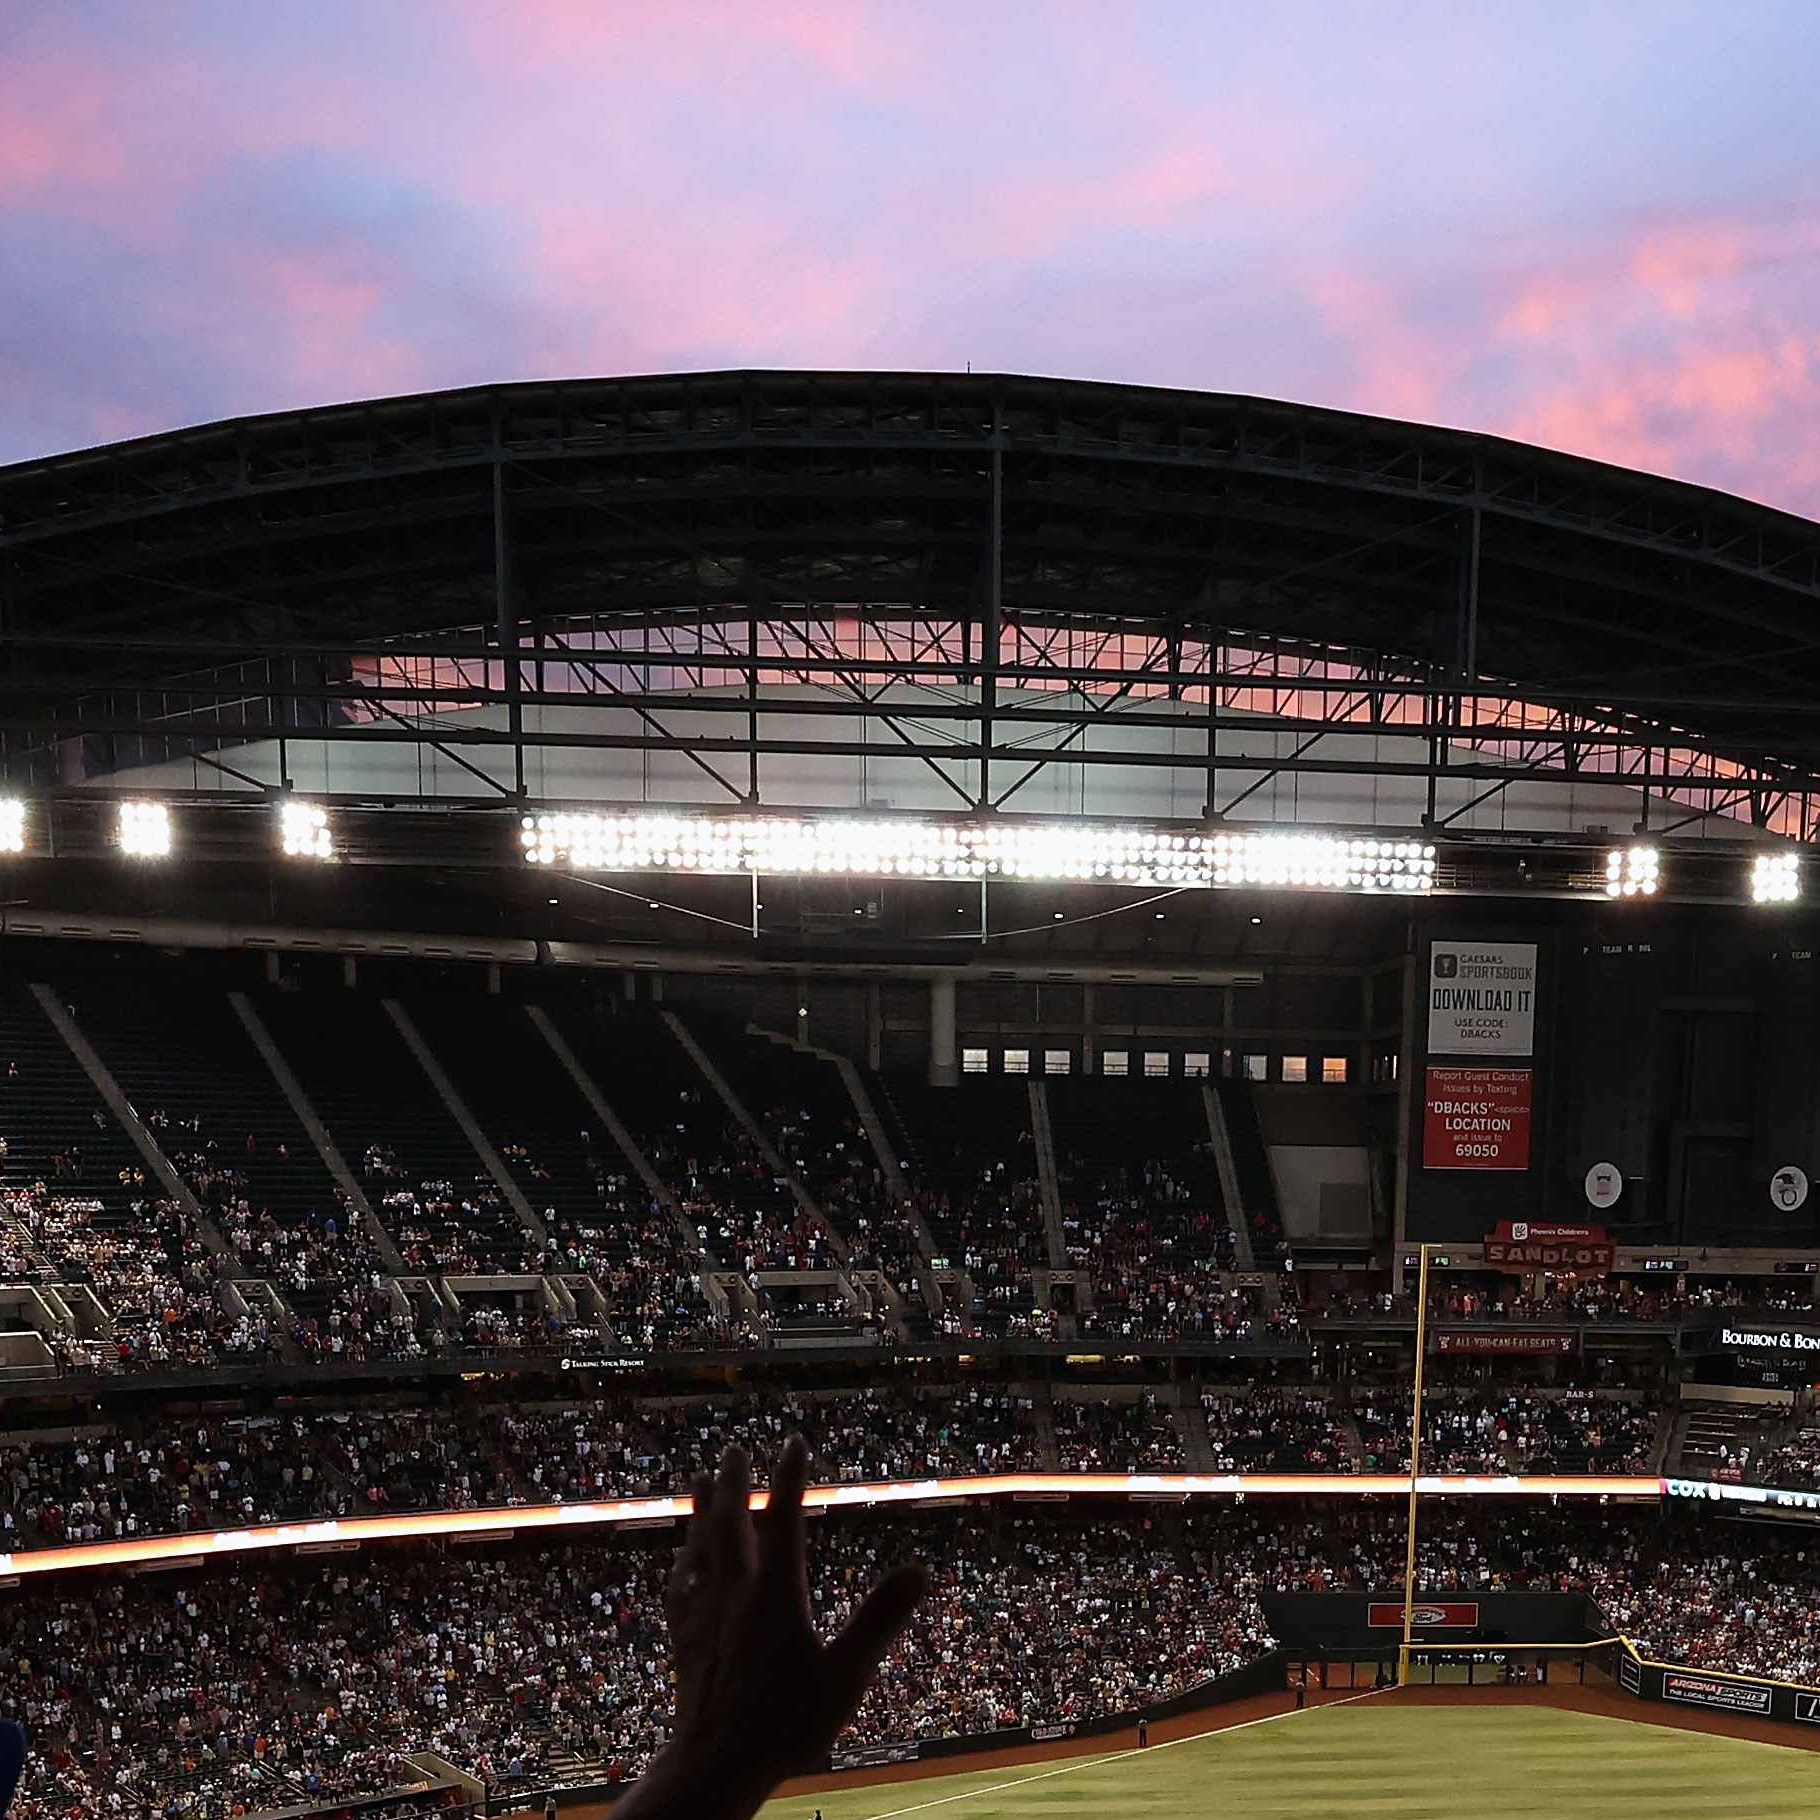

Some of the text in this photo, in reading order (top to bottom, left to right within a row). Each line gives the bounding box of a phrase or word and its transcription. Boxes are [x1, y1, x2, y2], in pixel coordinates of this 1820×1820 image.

[1460, 954, 1503, 964] CAESARS
[1459, 966, 1532, 980] SPORTSBOOK
[1433, 989, 1531, 1012] DOWNLOAD IT
[1455, 1018, 1508, 1029] USE CODE:
[1460, 1029, 1501, 1039] DBACKS
[1433, 1071, 1529, 1082] Report Guest Conduct
[1473, 1084, 1484, 1095] by
[1487, 1084, 1517, 1096] Texting
[1445, 1118, 1511, 1131] LOCATION
[1453, 1133, 1468, 1142] and
[1455, 1144, 1499, 1157] 69050
[1489, 1246, 1609, 1265] SANDLOT
[1780, 1333, 1792, 1348] &
[571, 1359, 645, 1368] TALKING STICK RESORT
[1566, 1389, 1594, 1399] BAR-S
[1668, 1480, 1705, 1498] COX
[1669, 1679, 1769, 1703] ARIZONA SPORTS
[1669, 1688, 1765, 1709] THE LOCAL SPORTS LEADER
